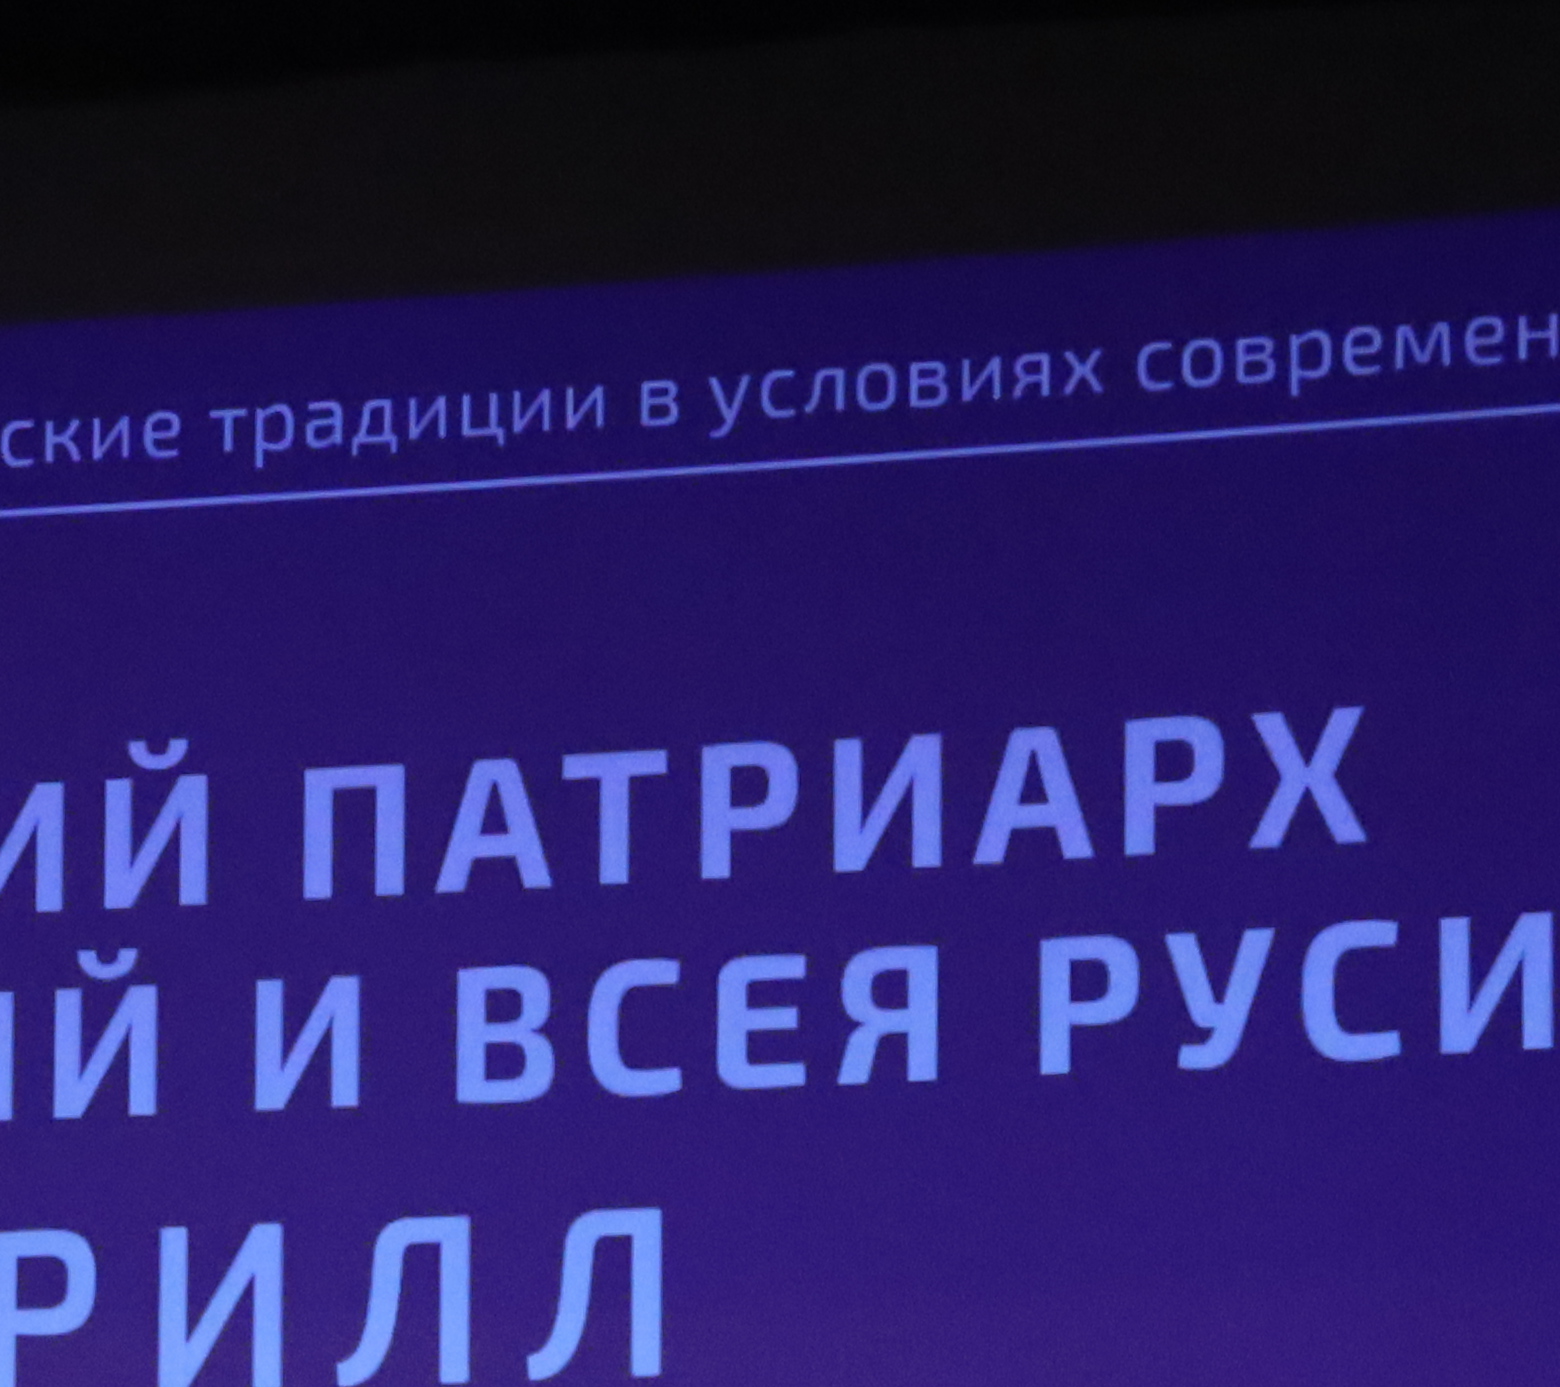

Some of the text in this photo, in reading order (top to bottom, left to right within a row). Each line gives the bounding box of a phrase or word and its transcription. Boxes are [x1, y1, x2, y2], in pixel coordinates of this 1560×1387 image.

[209, 386, 605, 468] традиции
[641, 380, 678, 426] в
[709, 350, 1102, 437] условиях
[302, 707, 1366, 900] ПАТРИАРХ
[253, 974, 361, 1112] И
[455, 944, 939, 1105] ВСЕЯ
[1039, 911, 1554, 1076] РУСИ
